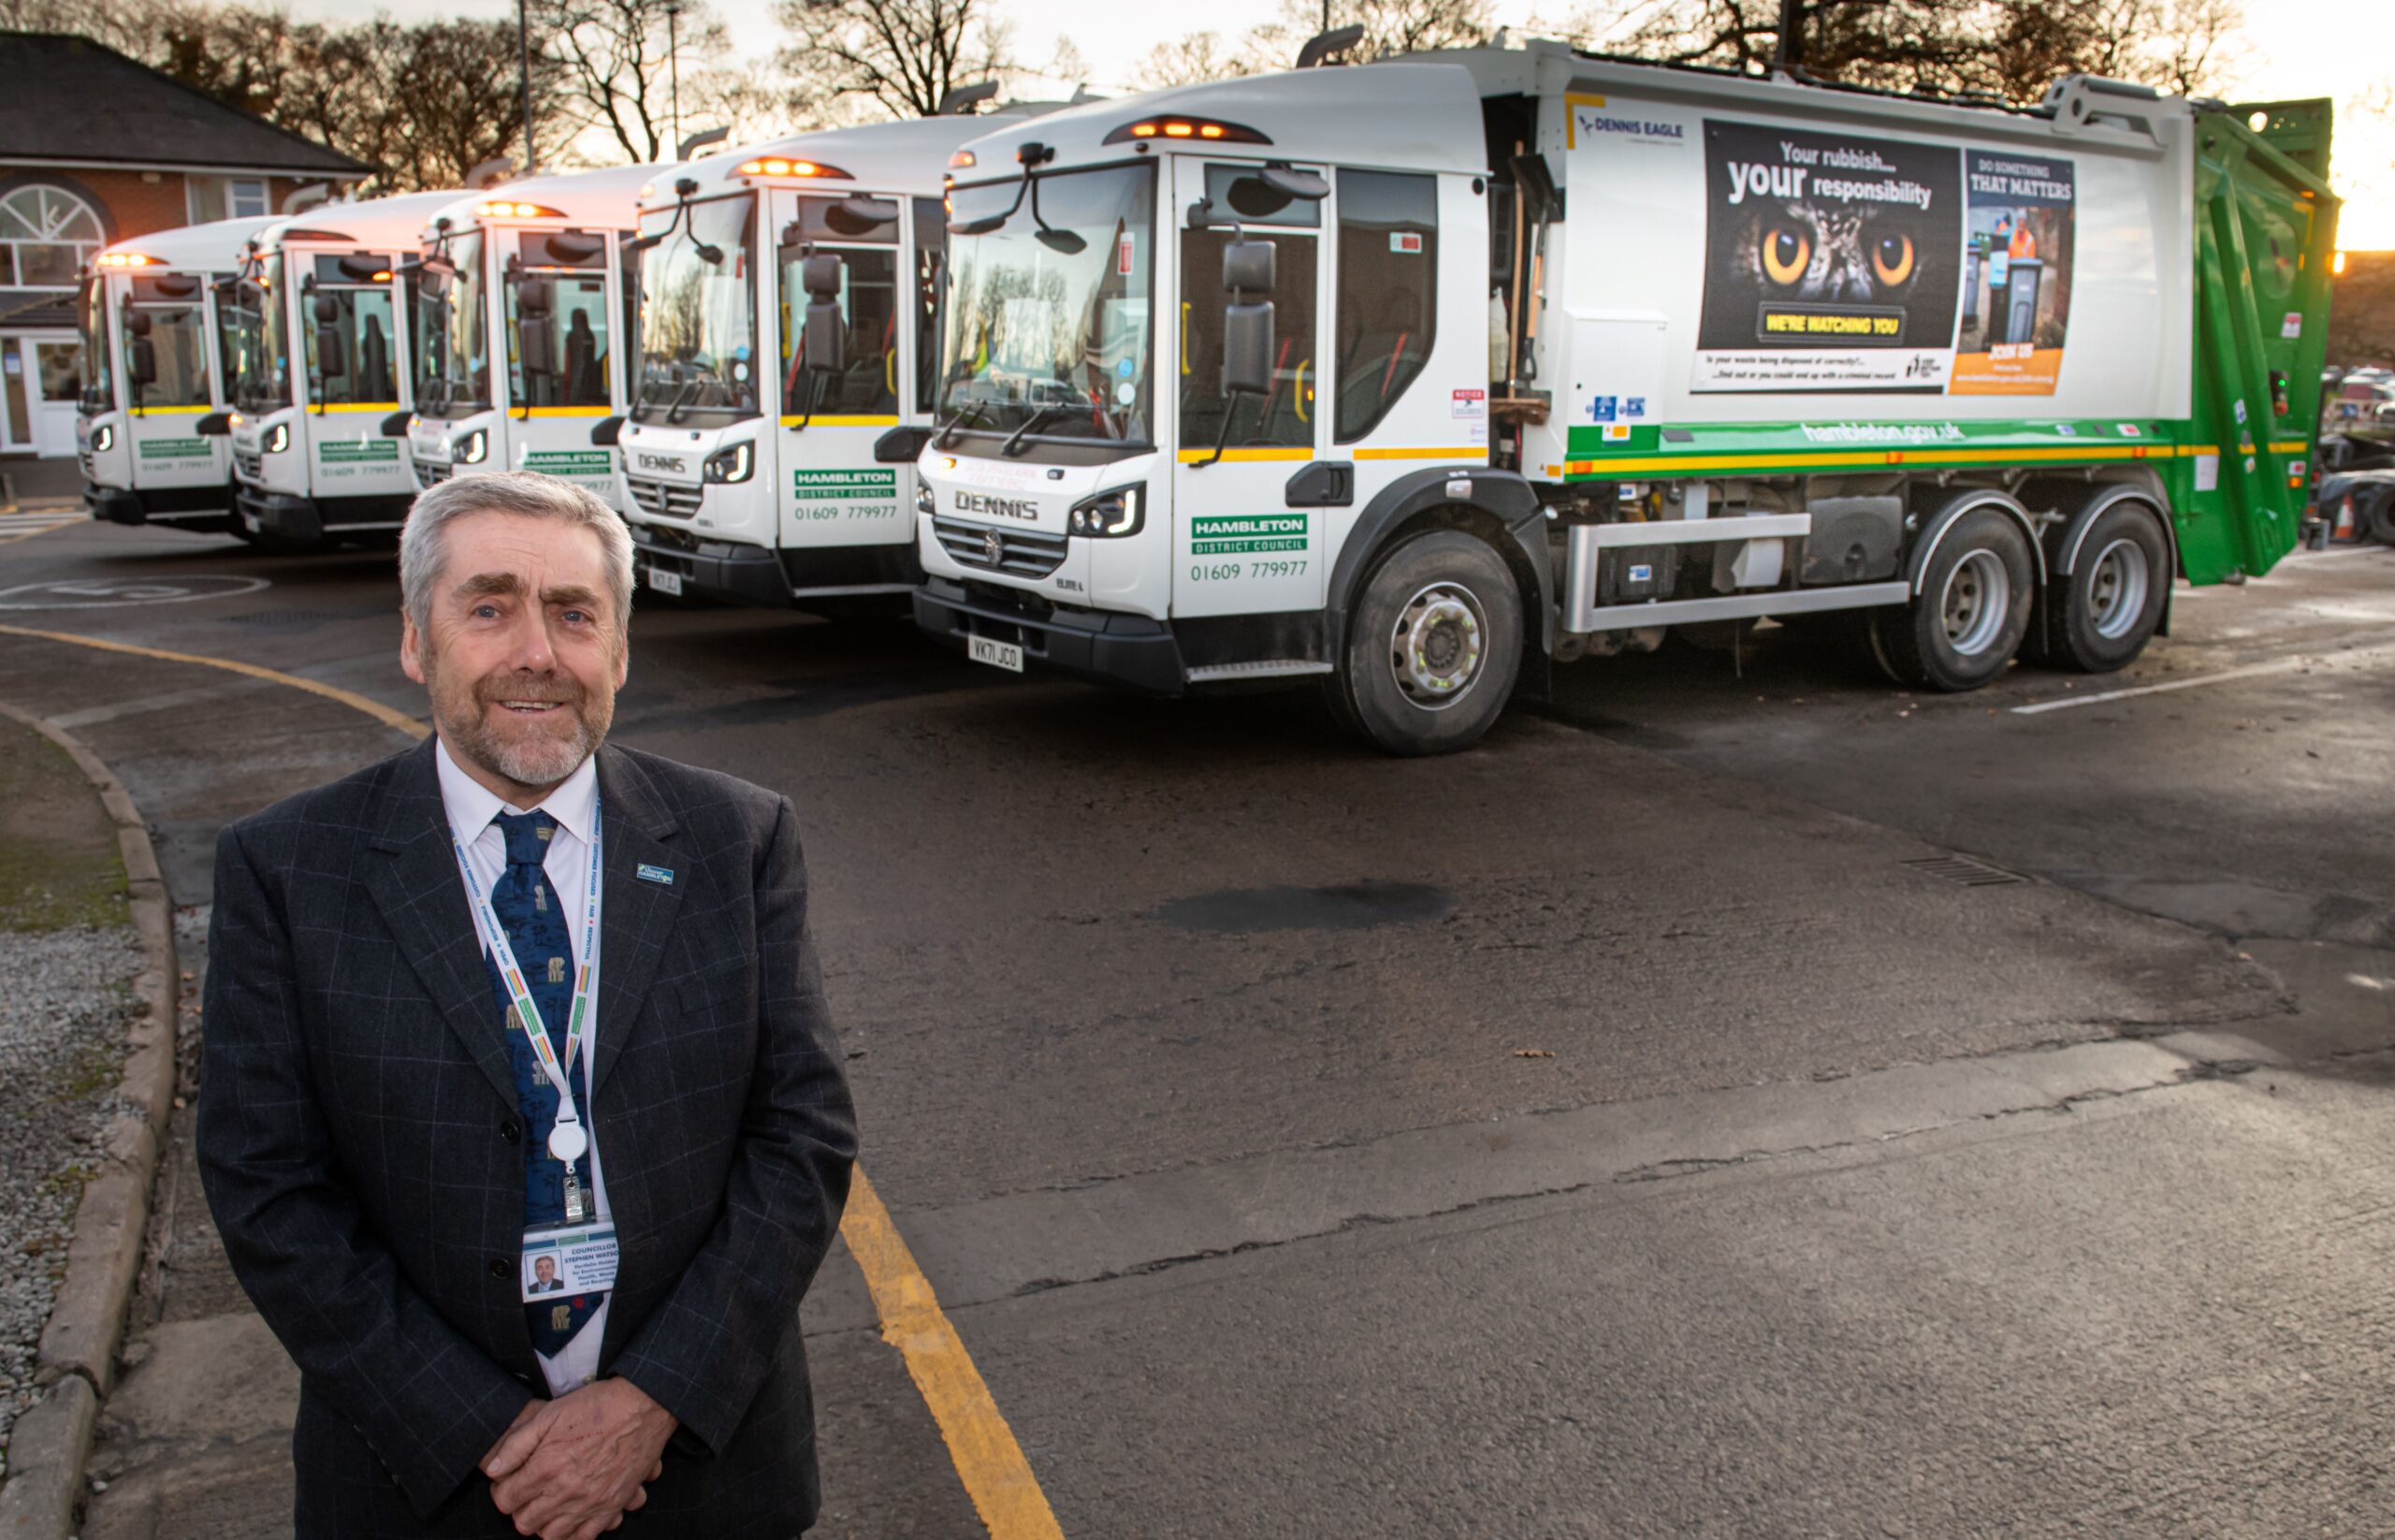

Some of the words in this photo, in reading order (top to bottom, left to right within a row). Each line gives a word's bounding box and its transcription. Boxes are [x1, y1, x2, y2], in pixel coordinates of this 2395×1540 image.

[1595, 117, 1640, 134] DENNIS
[1644, 122, 1683, 138] EAGLE
[1780, 141, 1819, 164] Your
[1823, 148, 1896, 173] rubbish...
[1978, 158, 1994, 172] DO
[1995, 160, 2050, 178] SOMETHING
[1727, 161, 1807, 204] your
[1813, 178, 1932, 211] responsibility
[1970, 173, 2007, 194] THAT
[2010, 178, 2072, 200] MATTERS
[1766, 314, 1807, 332] WE'RE
[1807, 315, 1871, 334] WATCHING
[1874, 318, 1899, 335] YOU
[1801, 422, 1965, 443] hambleton.gov.uk
[639, 453, 685, 474] DENNIS
[798, 472, 893, 484] HAMBLETON
[798, 489, 844, 498] DISTRICT
[849, 488, 892, 498] COUNCIL
[795, 507, 839, 520] 01609
[847, 505, 897, 518] 779977
[955, 490, 1038, 521] DENNIS
[1196, 519, 1304, 534] HAMBLETON
[1197, 542, 1250, 553] DISTRICT
[1254, 540, 1303, 551] COUNCIL
[1191, 563, 1241, 581] 01609
[1251, 560, 1308, 578] 779977
[1056, 578, 1078, 591] ELITE
[974, 639, 995, 662] VK71
[998, 646, 1017, 667] JCO
[584, 927, 593, 960] RESPECTFUL
[564, 1254, 595, 1264] STEPHEN
[572, 1243, 617, 1255] COUNCILLOR
